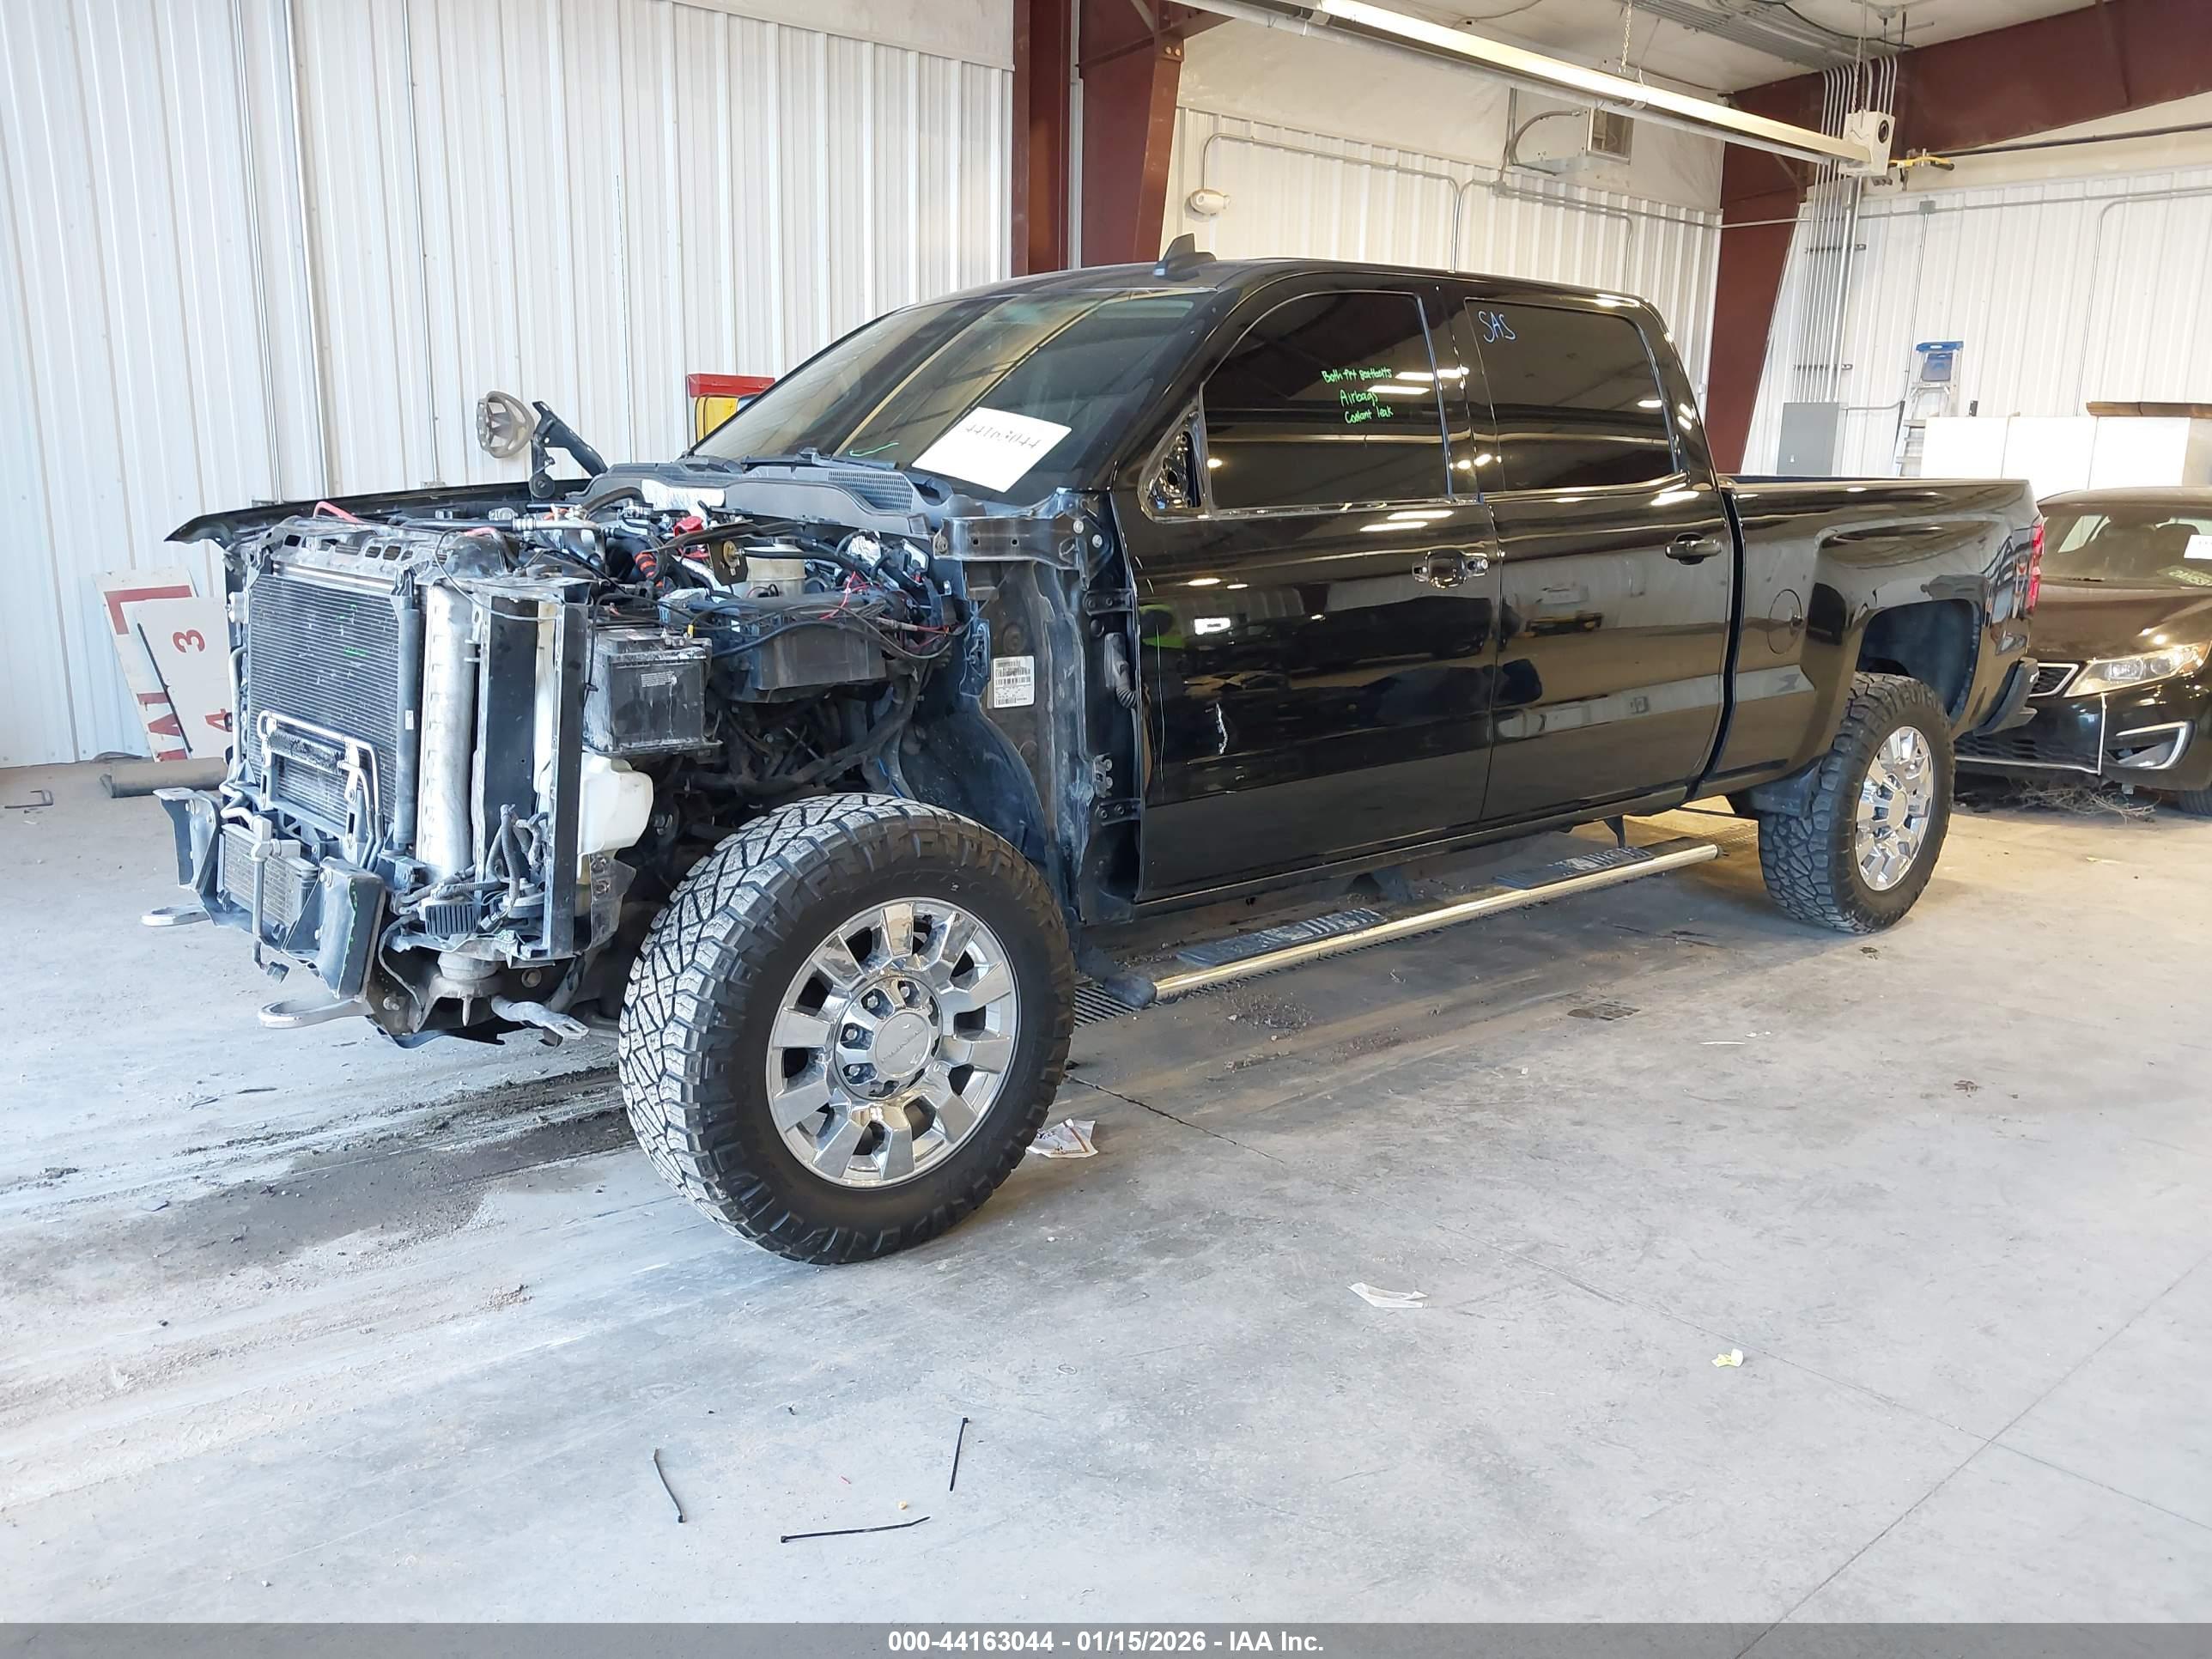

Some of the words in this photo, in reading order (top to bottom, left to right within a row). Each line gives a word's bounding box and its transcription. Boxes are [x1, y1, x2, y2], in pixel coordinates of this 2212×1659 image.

[1478, 310, 1516, 343] SAS
[1321, 368, 1343, 383] Both
[1340, 388, 1378, 408] Airbags
[1344, 408, 1372, 424] Coolant
[1376, 404, 1394, 418] leak
[172, 629, 206, 653] 3
